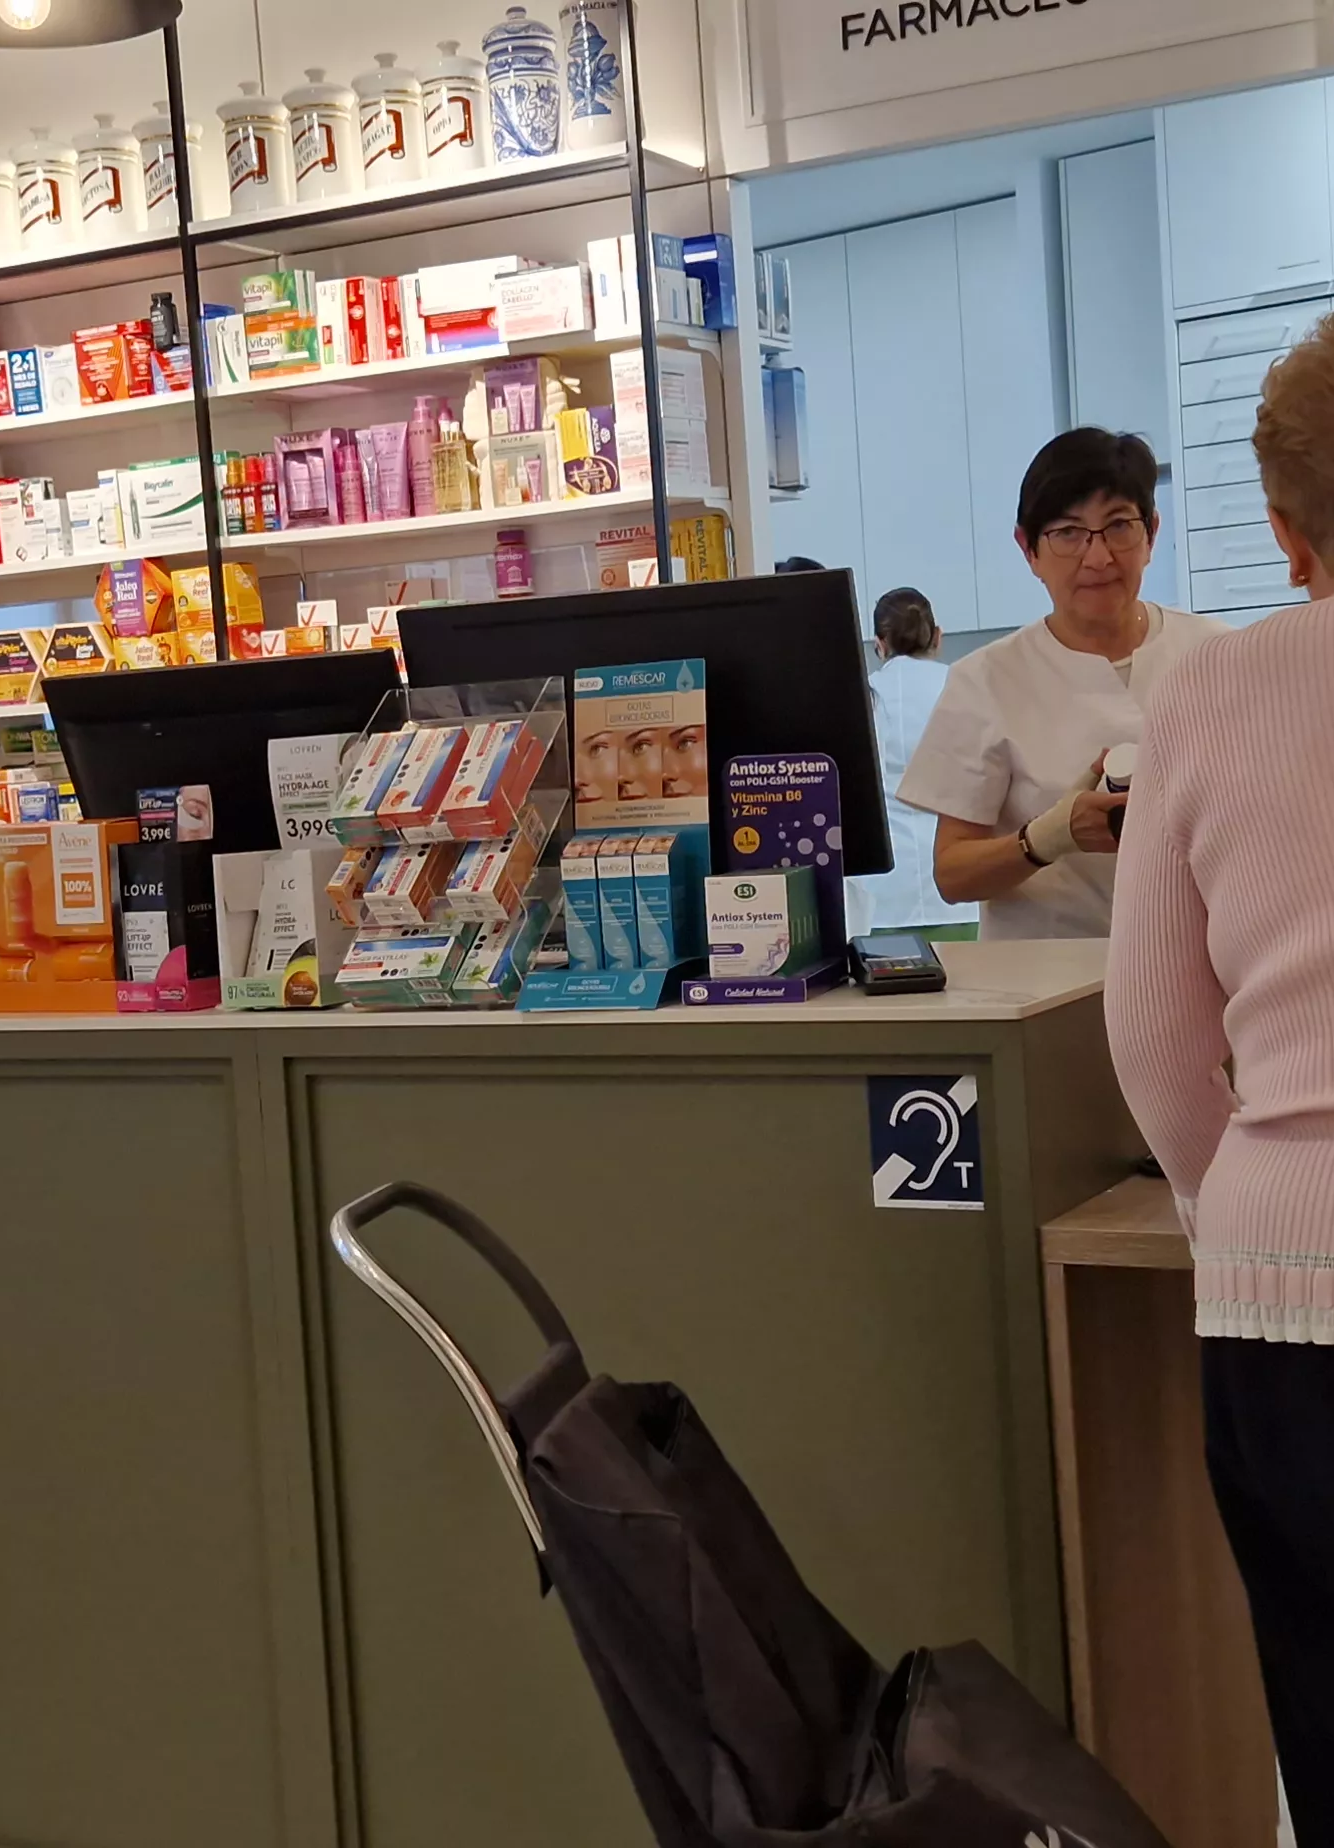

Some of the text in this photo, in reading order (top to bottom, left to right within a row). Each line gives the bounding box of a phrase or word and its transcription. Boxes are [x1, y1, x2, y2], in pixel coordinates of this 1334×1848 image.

[841, 0, 1089, 51] FARMAC
[243, 281, 273, 296] vitapil
[249, 333, 284, 349] vitapil
[599, 526, 651, 541] REVITAL
[695, 519, 708, 573] REVITAL
[612, 672, 666, 687] REMESCAR
[730, 759, 829, 777] Antiox System
[278, 780, 330, 791] HYDRA-AGE
[730, 779, 745, 787] con
[746, 776, 788, 787] POLI-GSH
[731, 790, 802, 803] Vitamina B6
[732, 804, 768, 818] y Zinc
[141, 827, 171, 842] 3,99€
[285, 818, 336, 840] 3,99€
[64, 880, 92, 893] 100%
[736, 885, 754, 897] ESI
[711, 911, 783, 923] Antiox System
[953, 1161, 974, 1188] T
